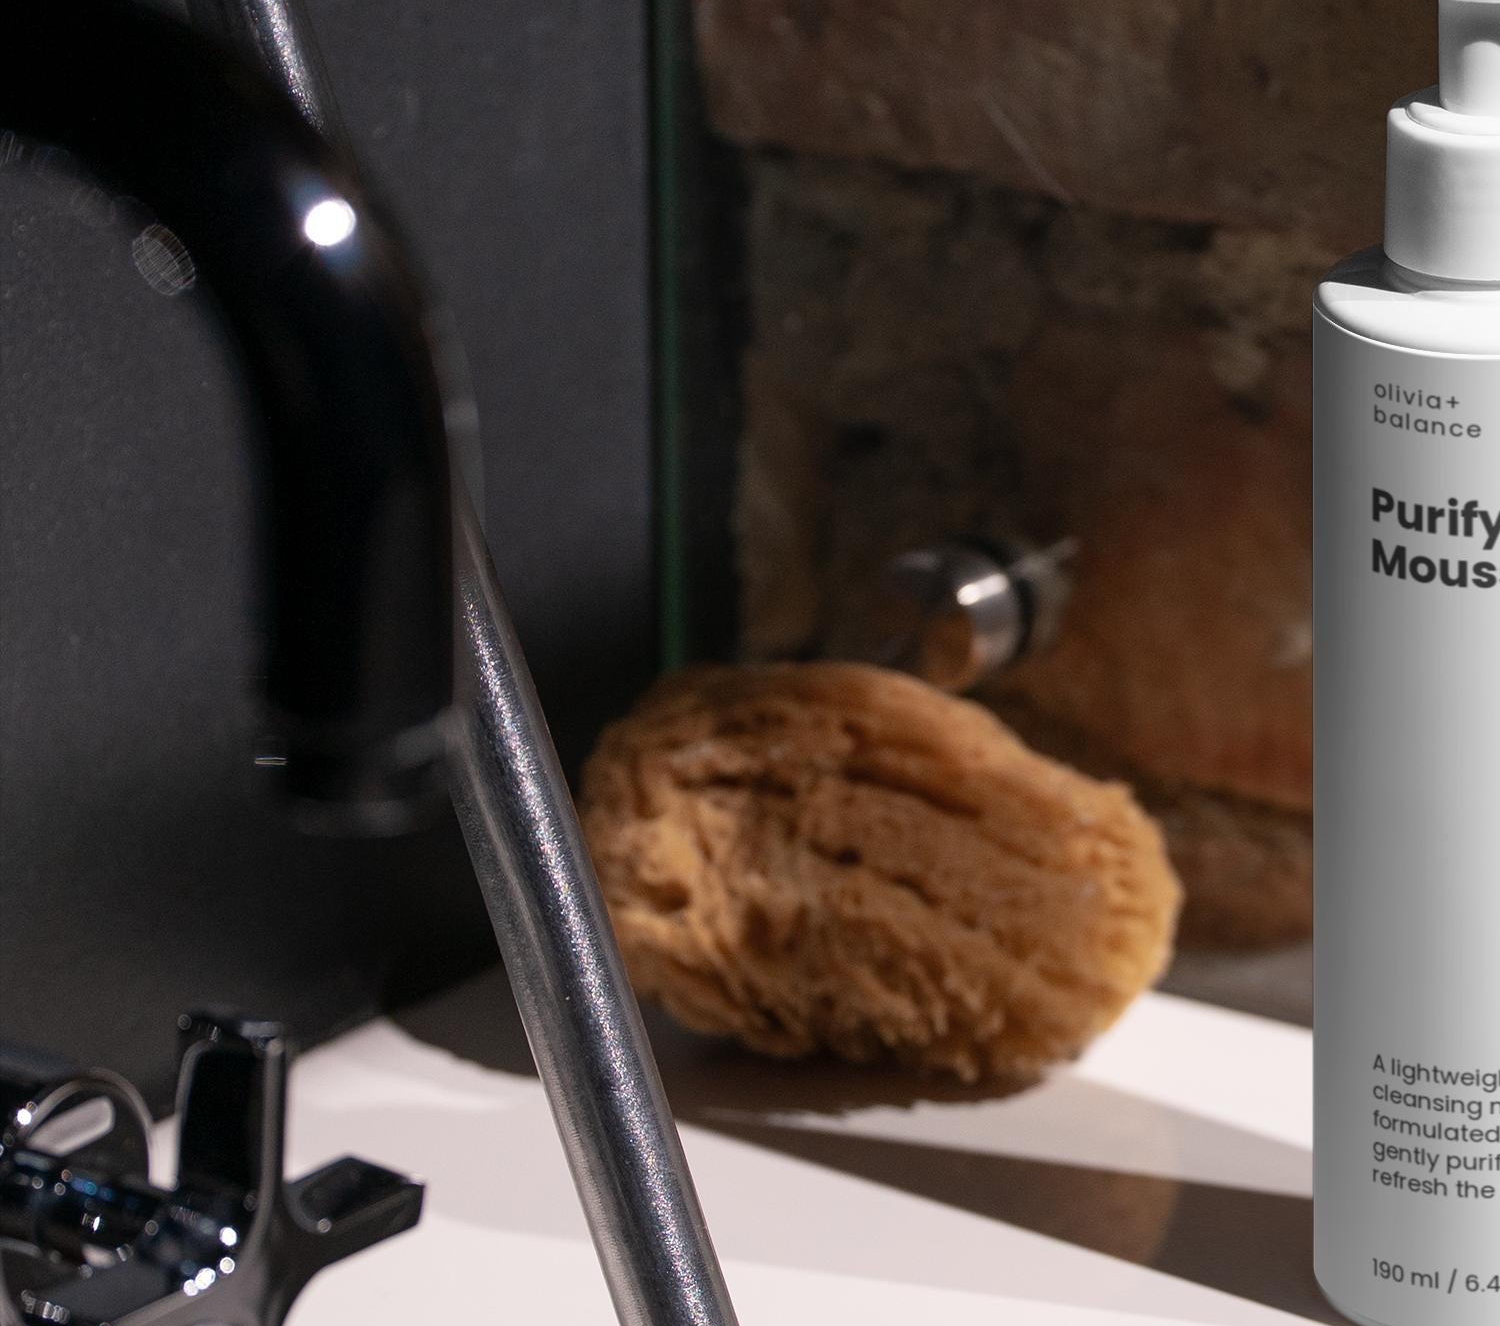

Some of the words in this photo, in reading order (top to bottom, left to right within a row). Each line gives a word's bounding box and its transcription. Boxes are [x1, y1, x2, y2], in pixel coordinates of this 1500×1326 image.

[1375, 384, 1459, 409] olivia+
[1374, 405, 1481, 438] balance
[1373, 1054, 1385, 1073] A
[1373, 1084, 1482, 1121] cleansing
[1373, 1110, 1500, 1143] formulated
[1373, 1142, 1440, 1173] gently
[1373, 1169, 1448, 1196] refresh
[1456, 1180, 1495, 1199] the
[1373, 1258, 1404, 1282] 190
[1411, 1272, 1439, 1289] ml
[1448, 1268, 1457, 1294] /
